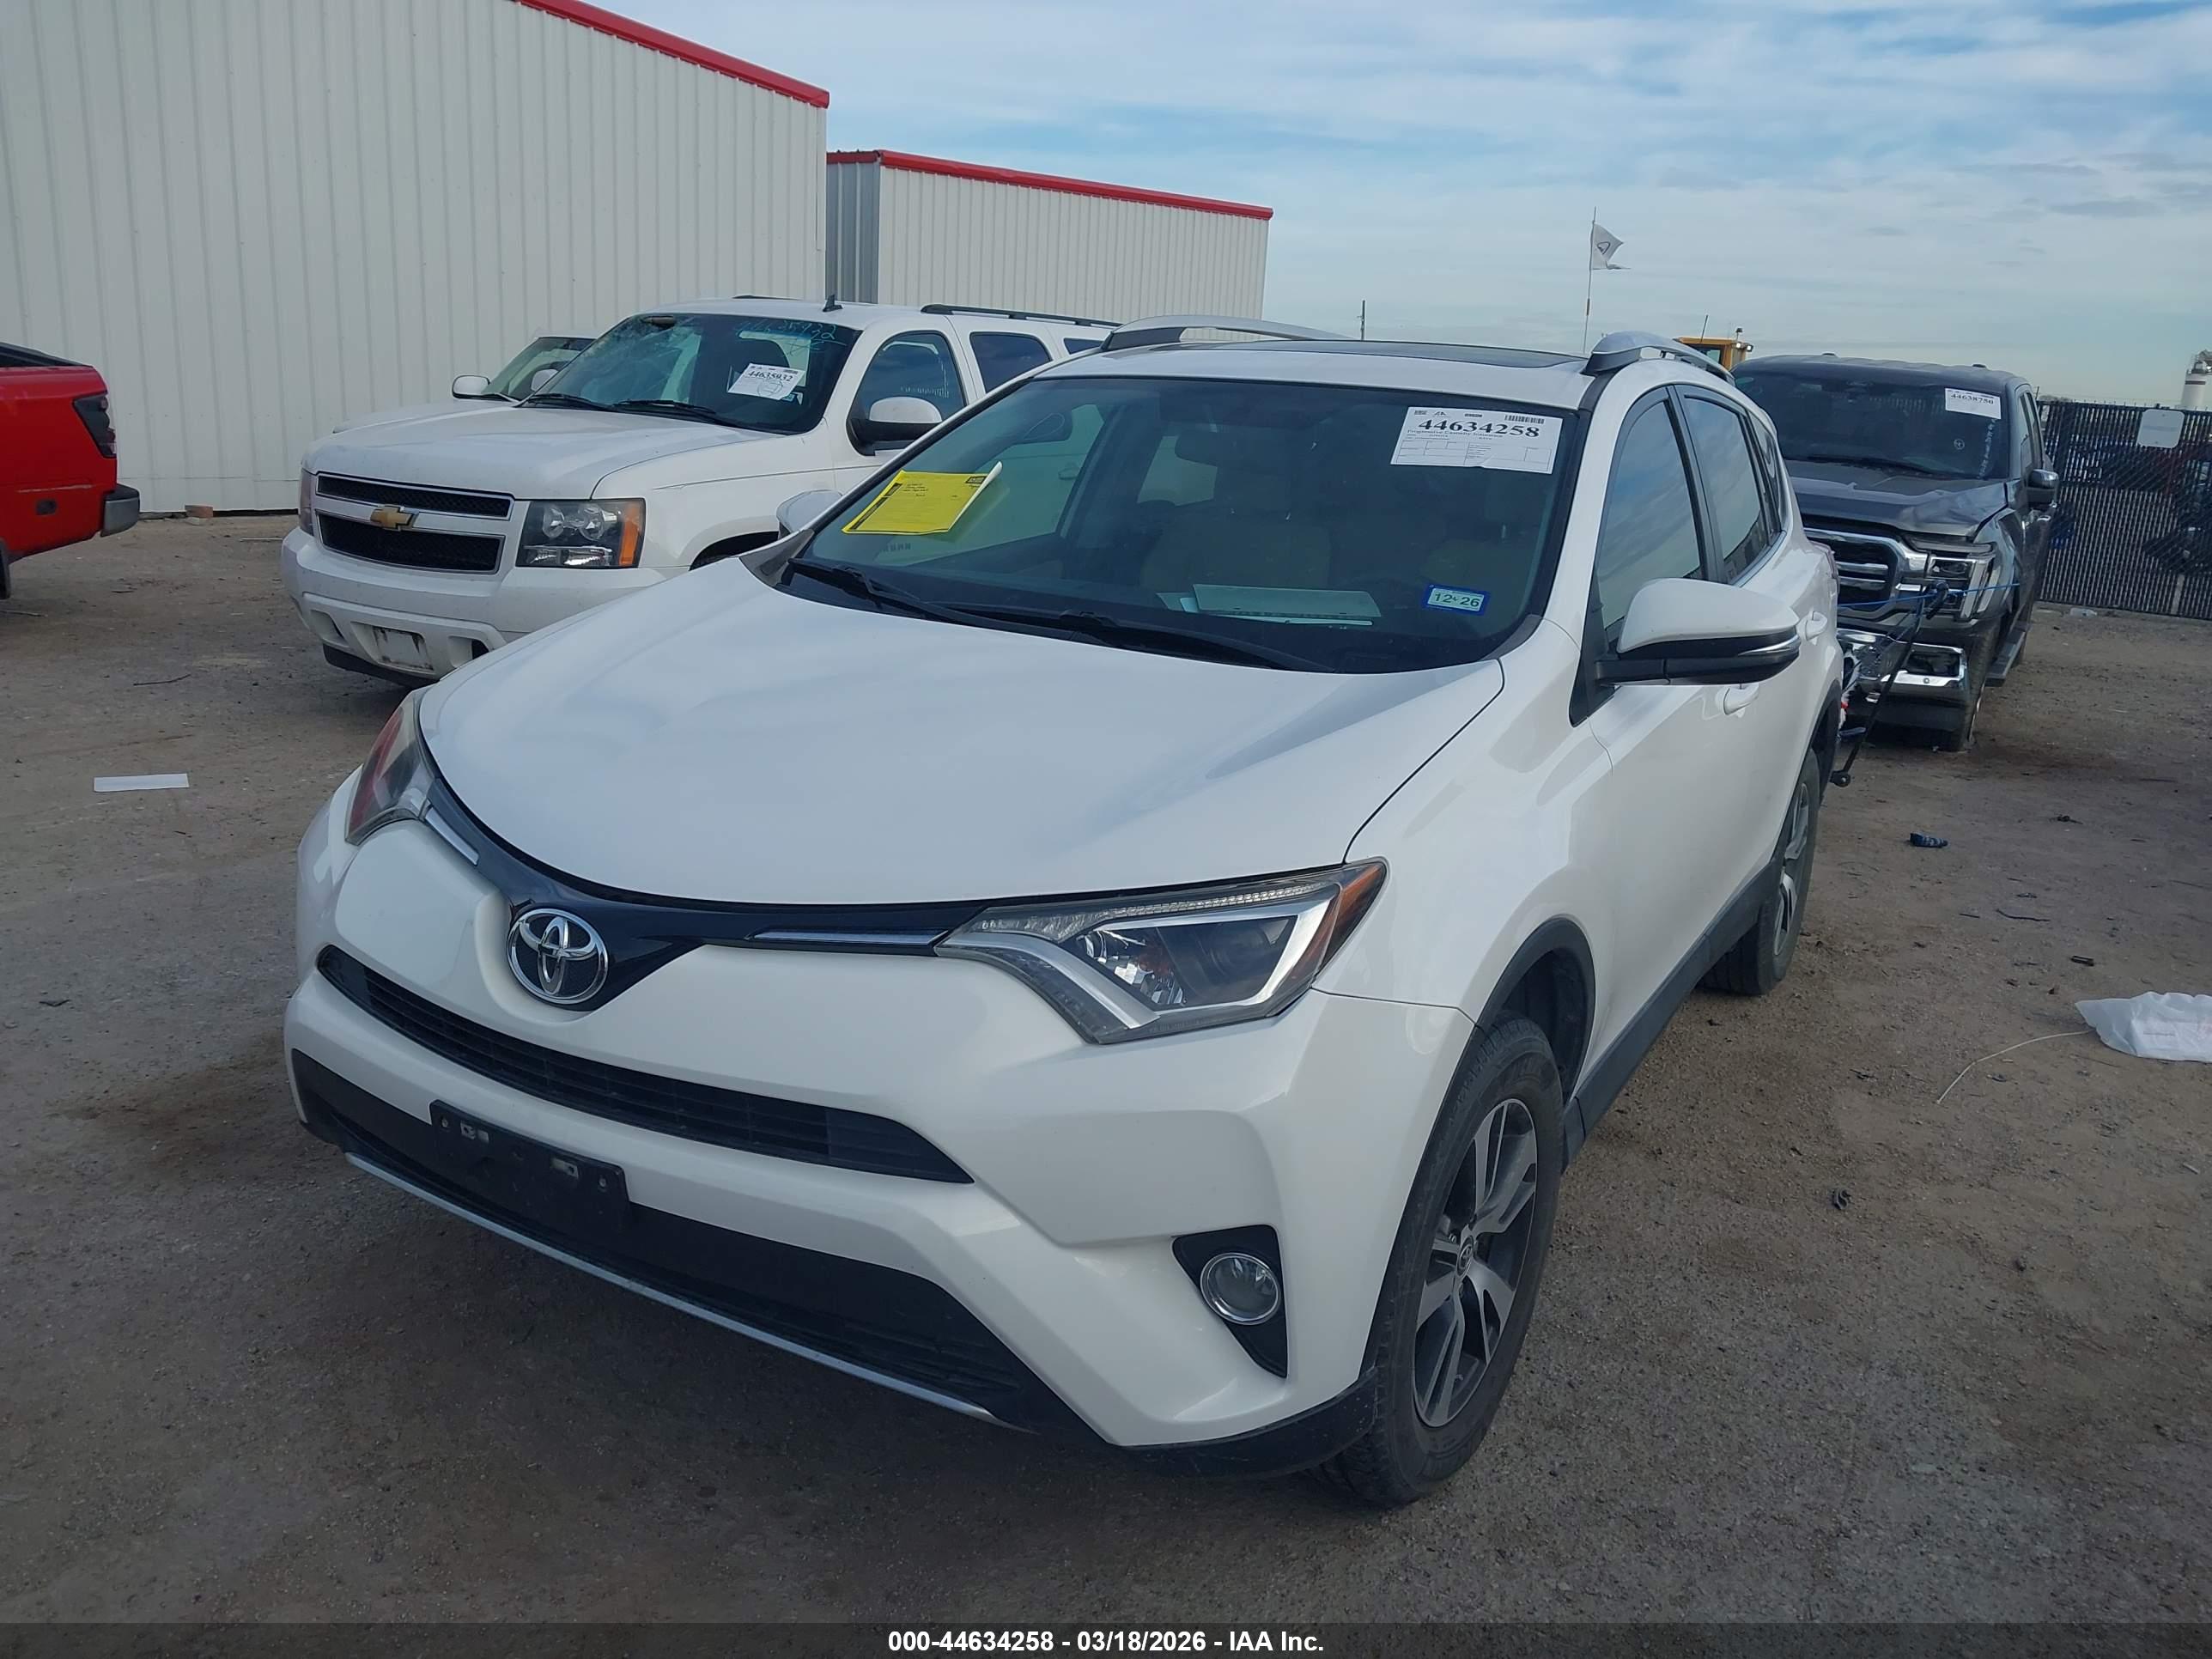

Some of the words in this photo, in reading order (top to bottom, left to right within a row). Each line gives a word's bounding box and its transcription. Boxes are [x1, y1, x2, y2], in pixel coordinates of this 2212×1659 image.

[1419, 419, 1540, 438] 44634258
[1435, 592, 1452, 603] 12
[1460, 596, 1481, 607] 26
